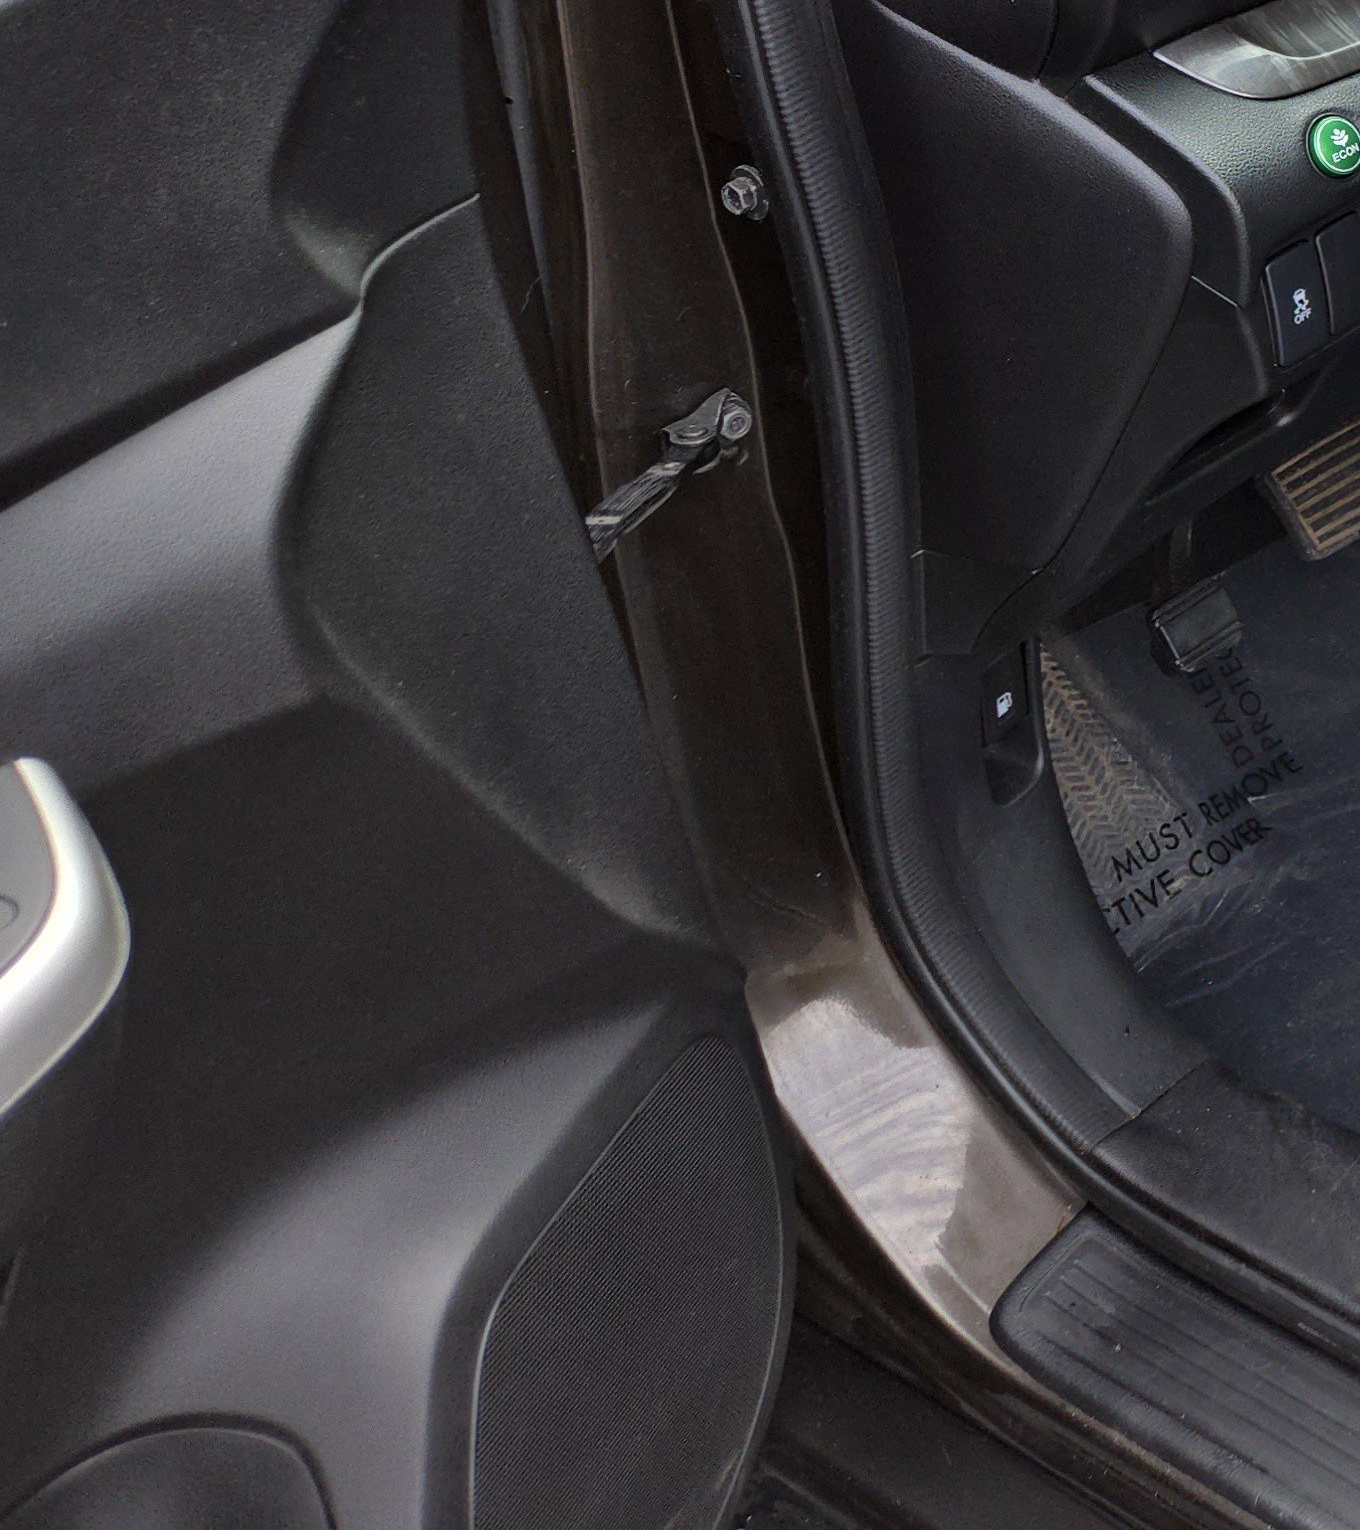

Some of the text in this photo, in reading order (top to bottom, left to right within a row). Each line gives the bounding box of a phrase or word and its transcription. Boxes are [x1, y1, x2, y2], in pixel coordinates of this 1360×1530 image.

[1331, 143, 1360, 163] ECON
[1294, 307, 1312, 325] OFF
[1110, 751, 1303, 883] MUST REMOVE
[1189, 817, 1273, 877] COVER
